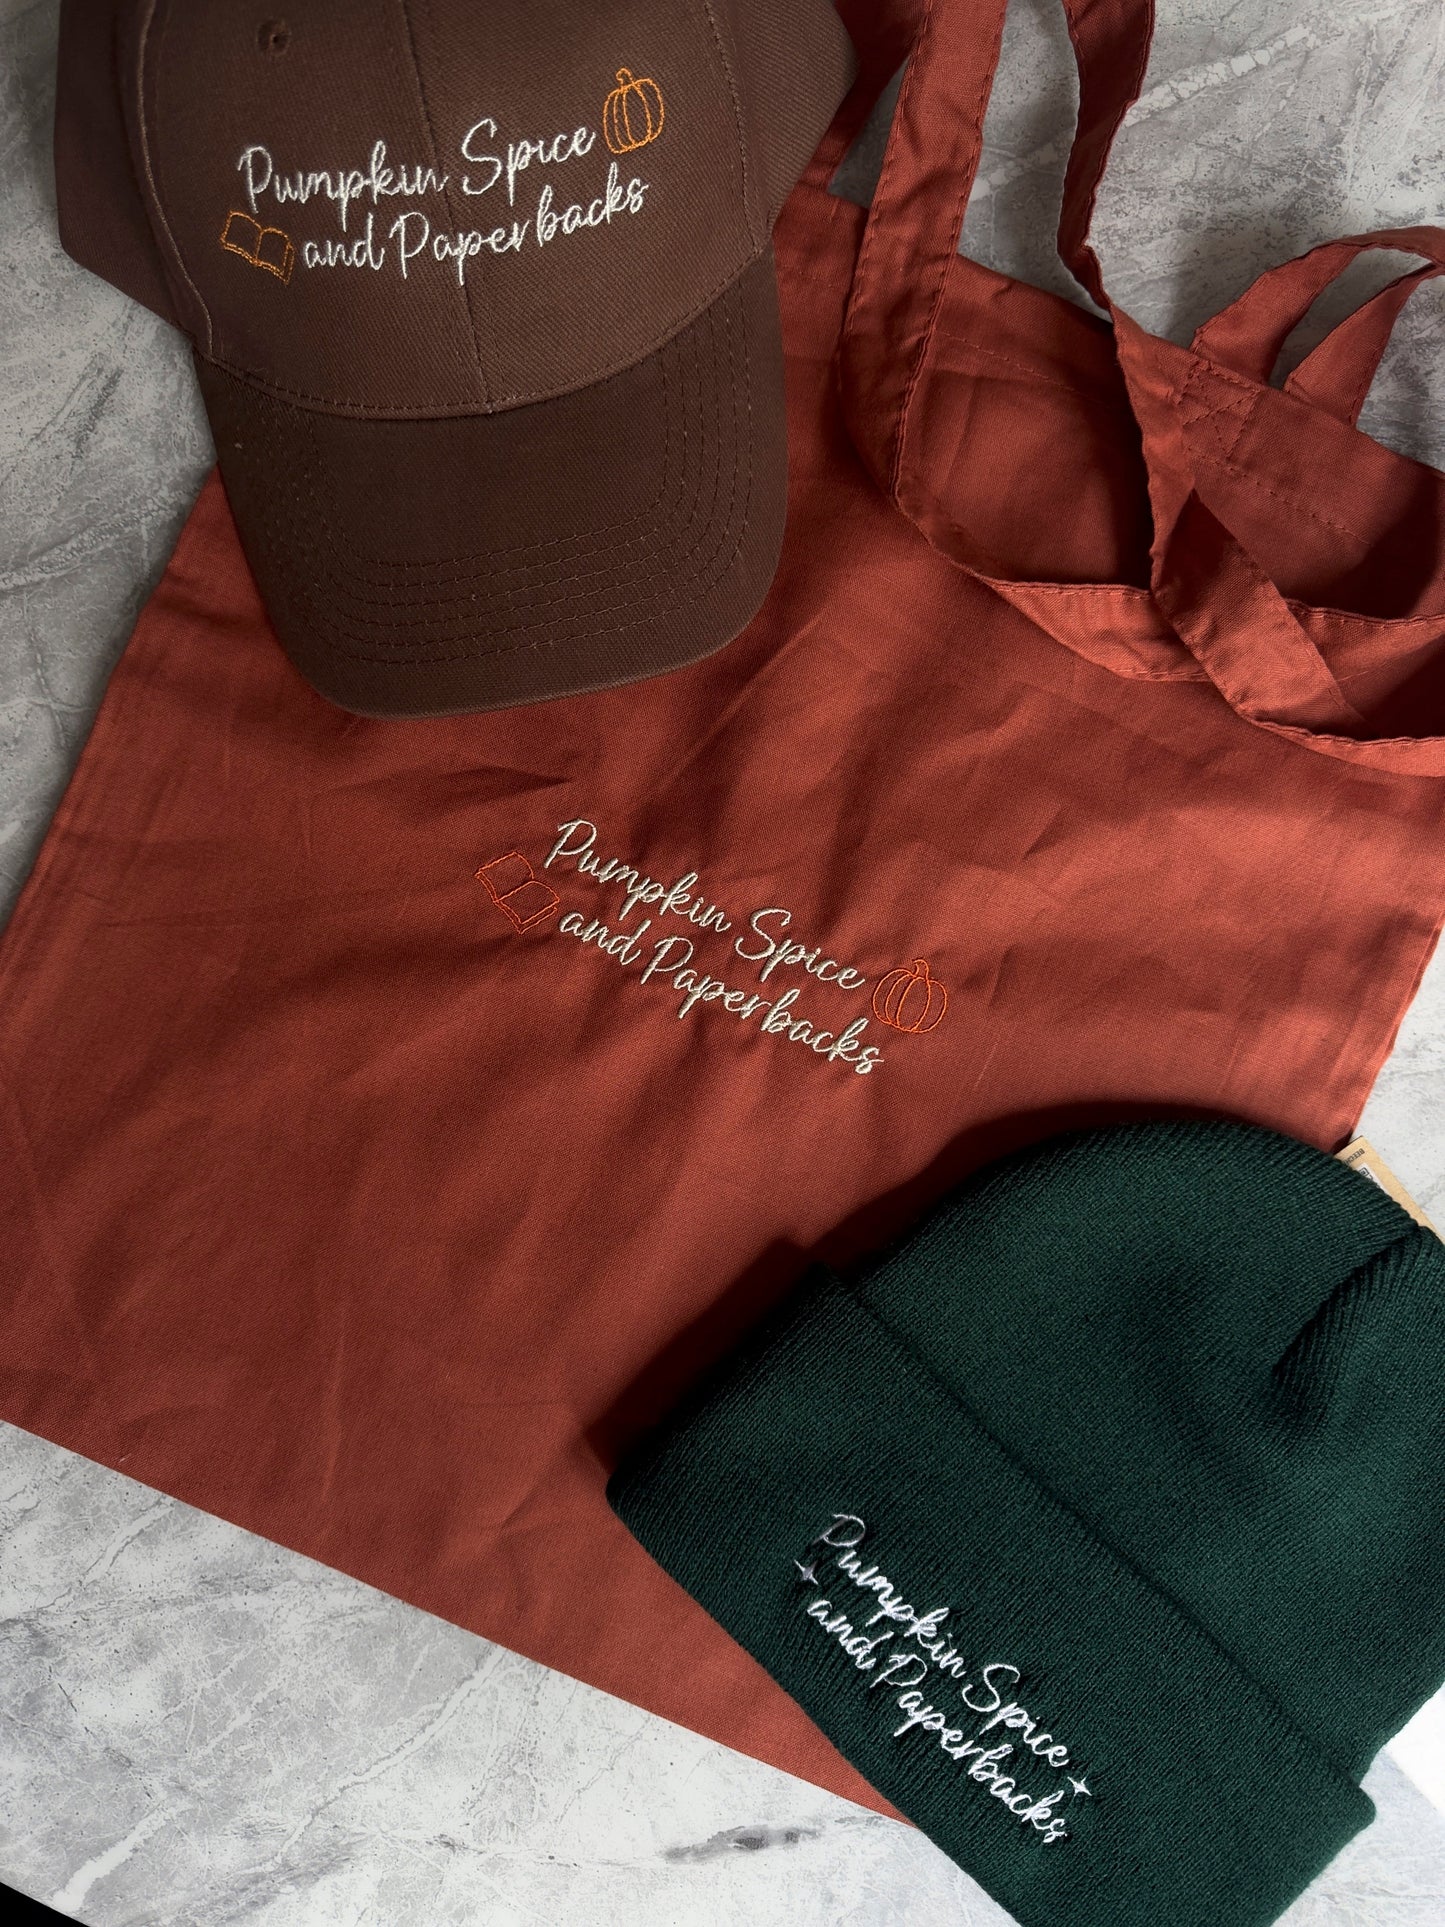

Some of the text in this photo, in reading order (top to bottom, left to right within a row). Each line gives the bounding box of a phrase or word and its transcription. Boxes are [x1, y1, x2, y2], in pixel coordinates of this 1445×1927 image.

[237, 118, 597, 232] Pumpkin Spice
[304, 162, 648, 286] and Paperbacks
[543, 817, 865, 991] Pumpkin Spice
[559, 908, 884, 1075] and Paperbacks
[806, 1599, 1068, 1844] and Paperbacks
[812, 1513, 1070, 1768] Pumpkin Spice
